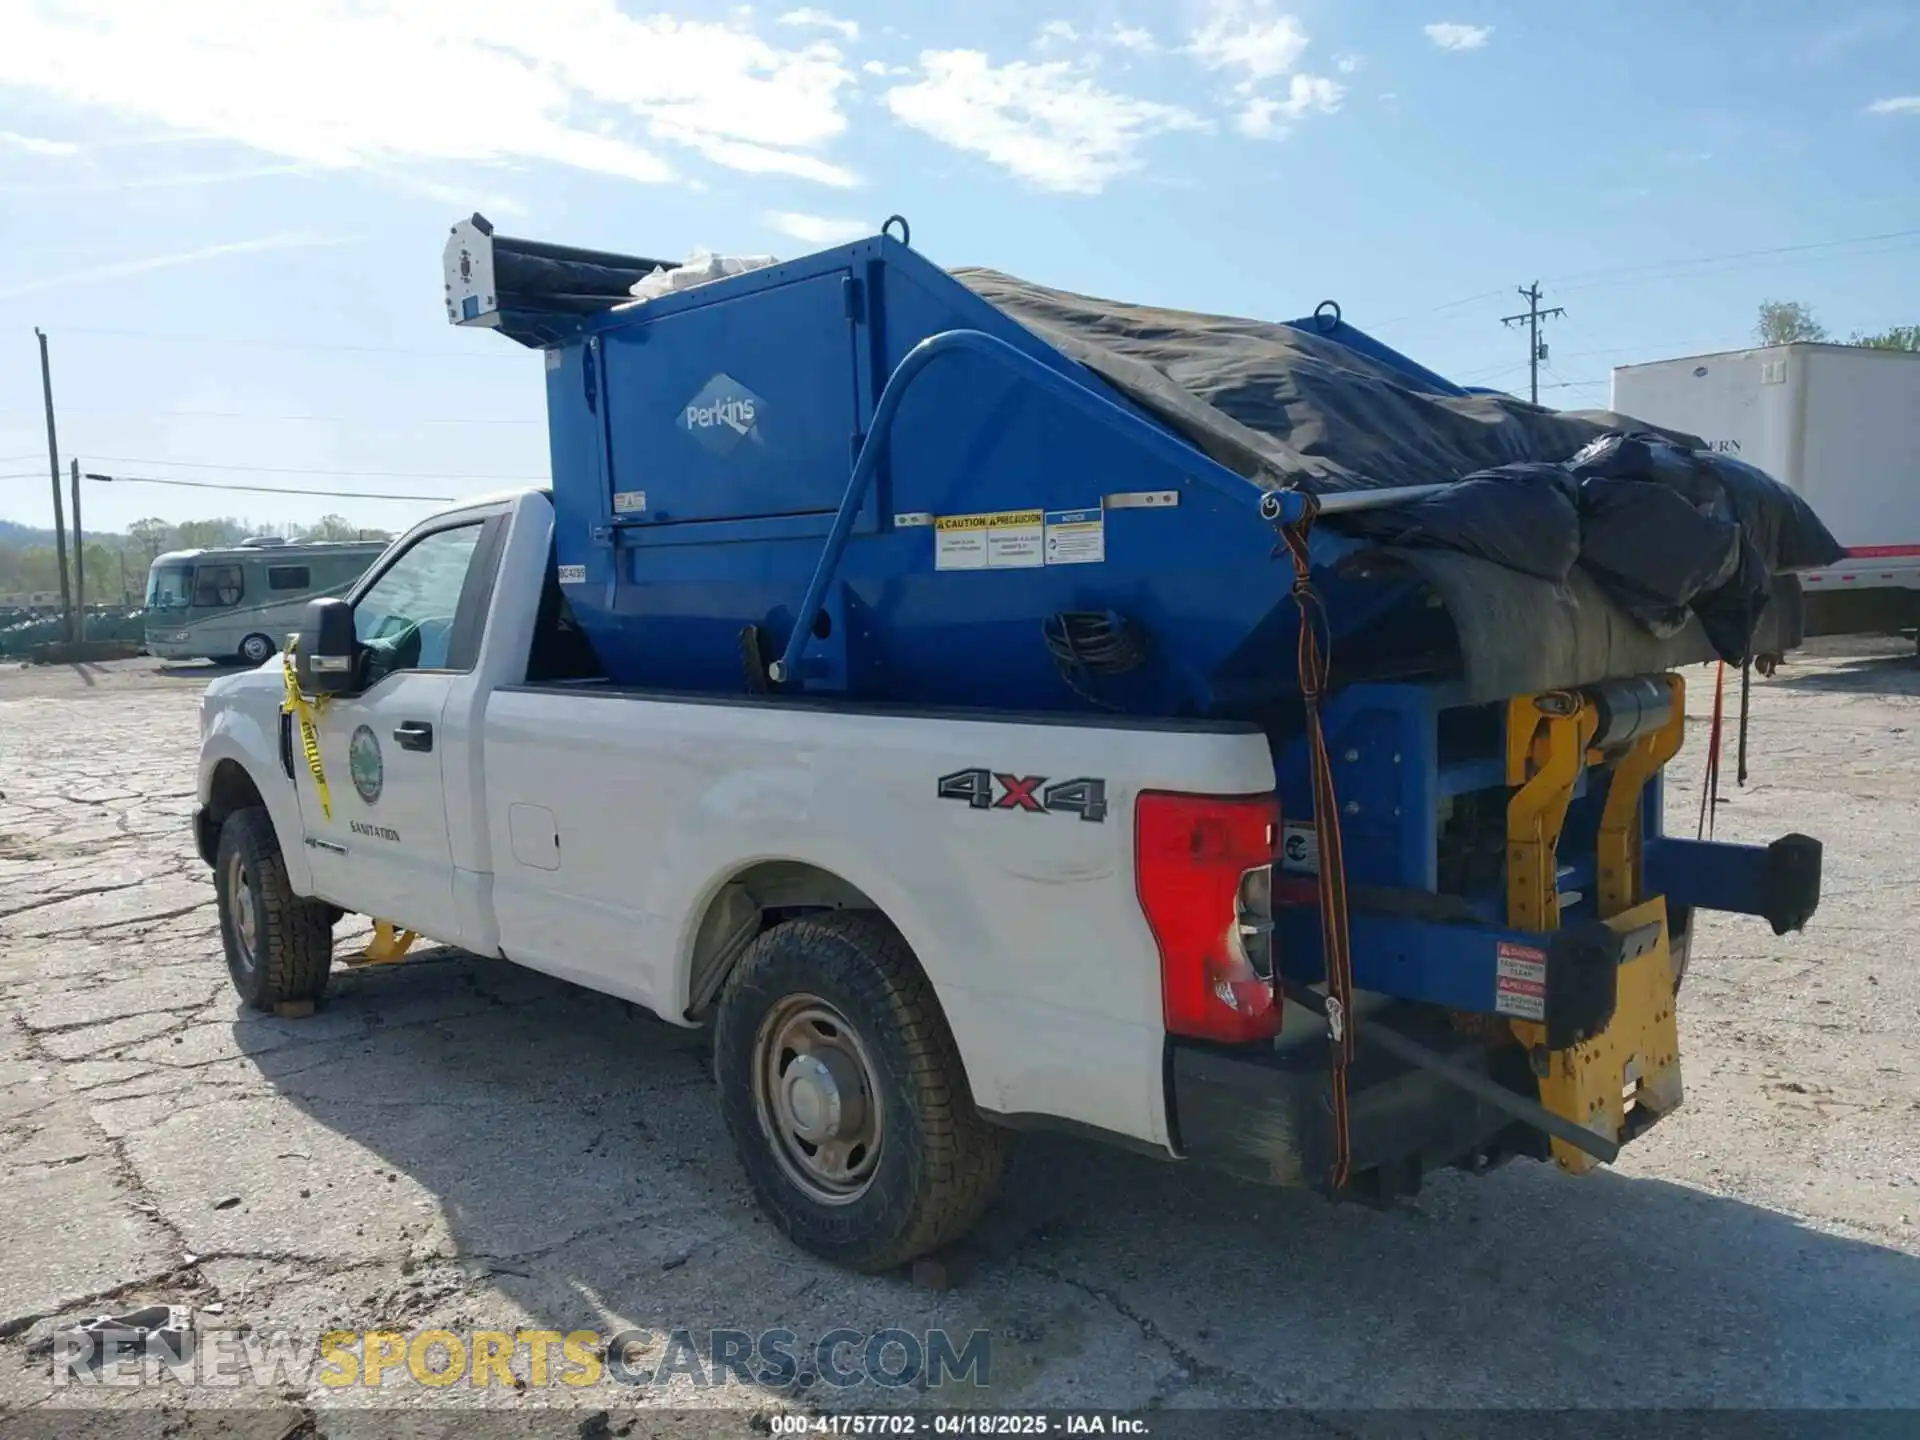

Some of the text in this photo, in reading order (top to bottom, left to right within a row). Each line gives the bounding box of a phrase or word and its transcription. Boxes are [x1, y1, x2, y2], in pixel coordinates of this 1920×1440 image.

[686, 396, 755, 435] Perkins
[944, 517, 986, 529] CAUTION
[937, 766, 1108, 823] 4X4
[349, 819, 401, 842] SANITATION
